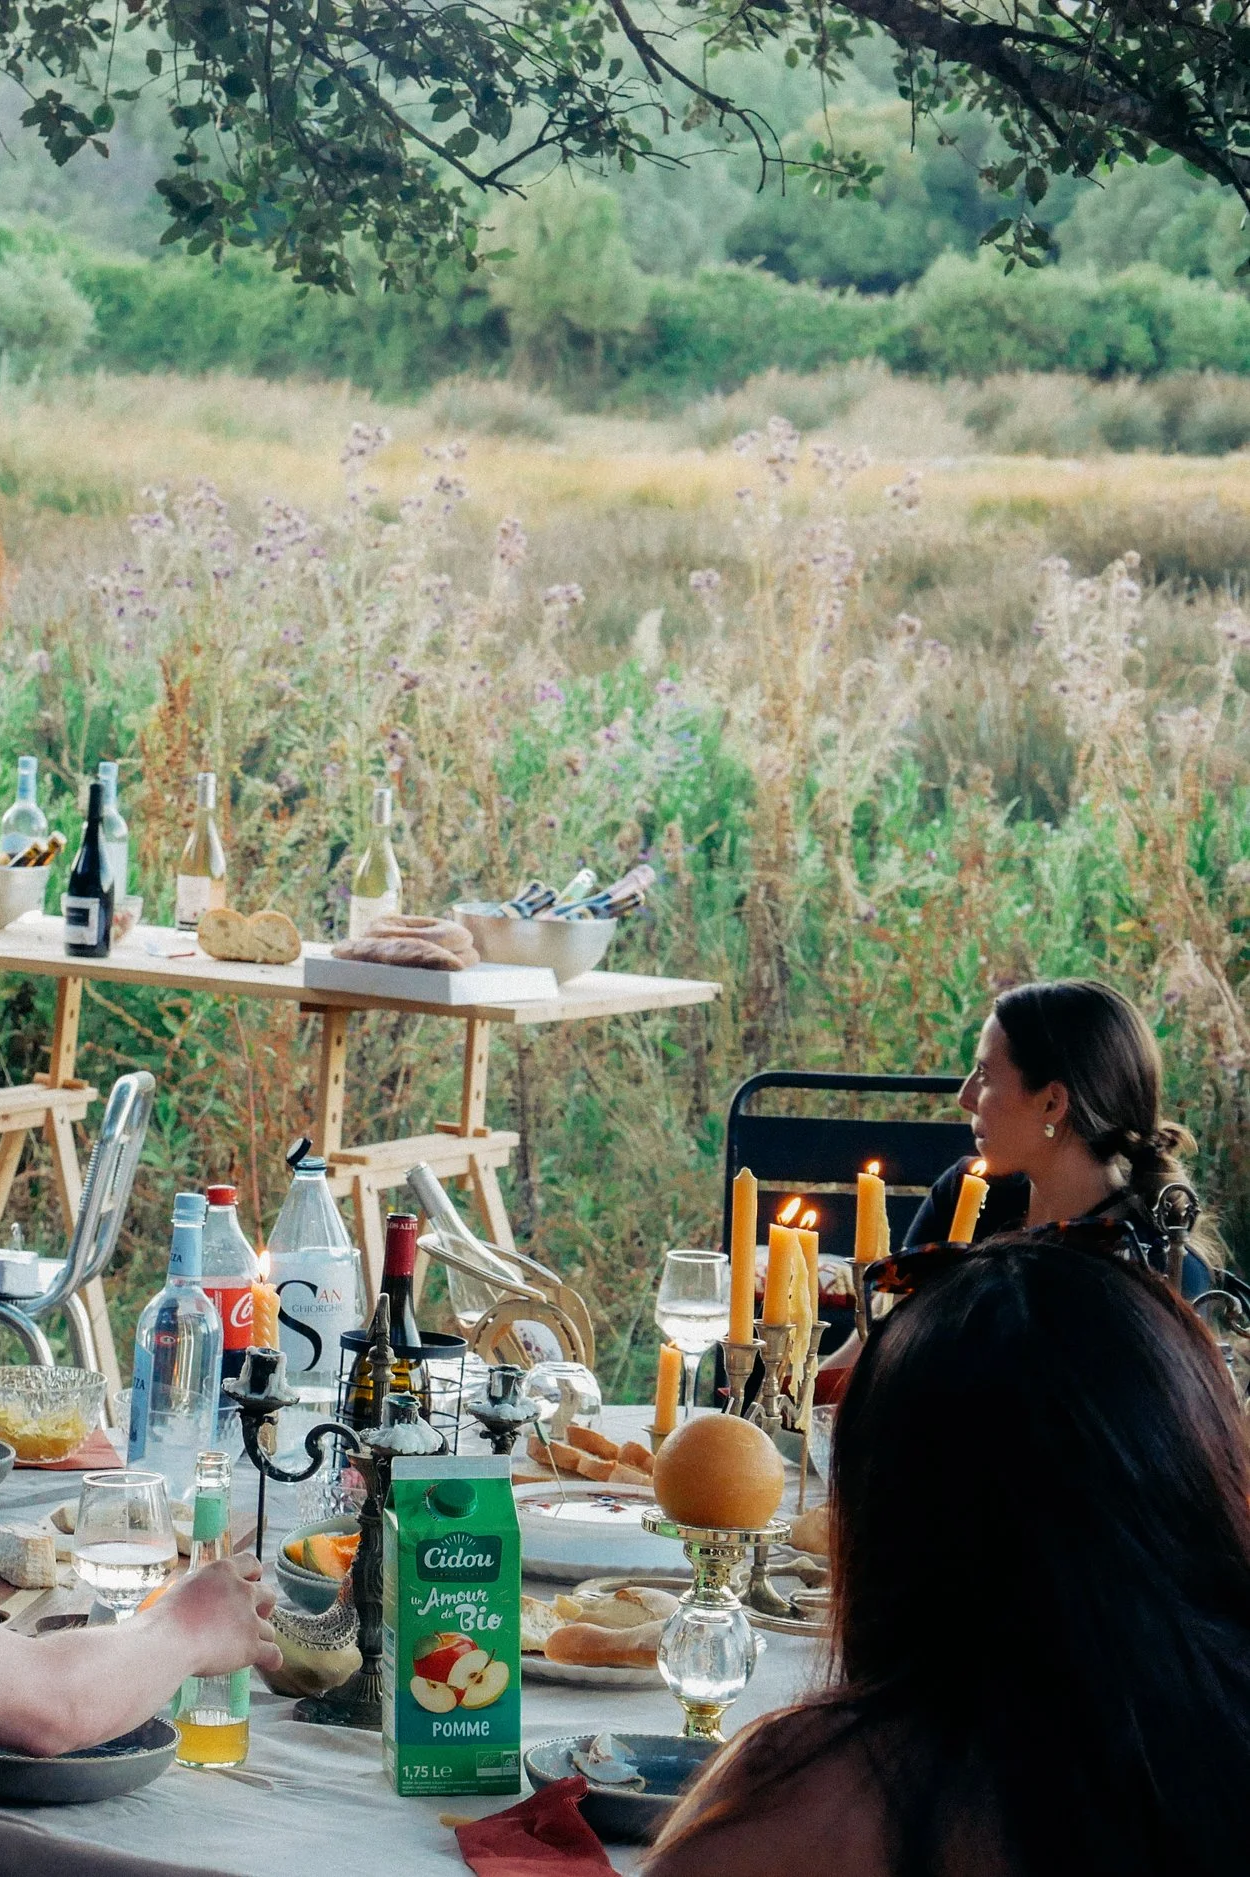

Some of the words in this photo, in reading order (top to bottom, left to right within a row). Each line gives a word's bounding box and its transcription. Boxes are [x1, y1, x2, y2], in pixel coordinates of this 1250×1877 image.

[423, 1547, 495, 1569] Cidou
[417, 1587, 489, 1616] Amour
[440, 1608, 455, 1620] de
[454, 1603, 503, 1632] Bio
[402, 1765, 429, 1780] 1,75
